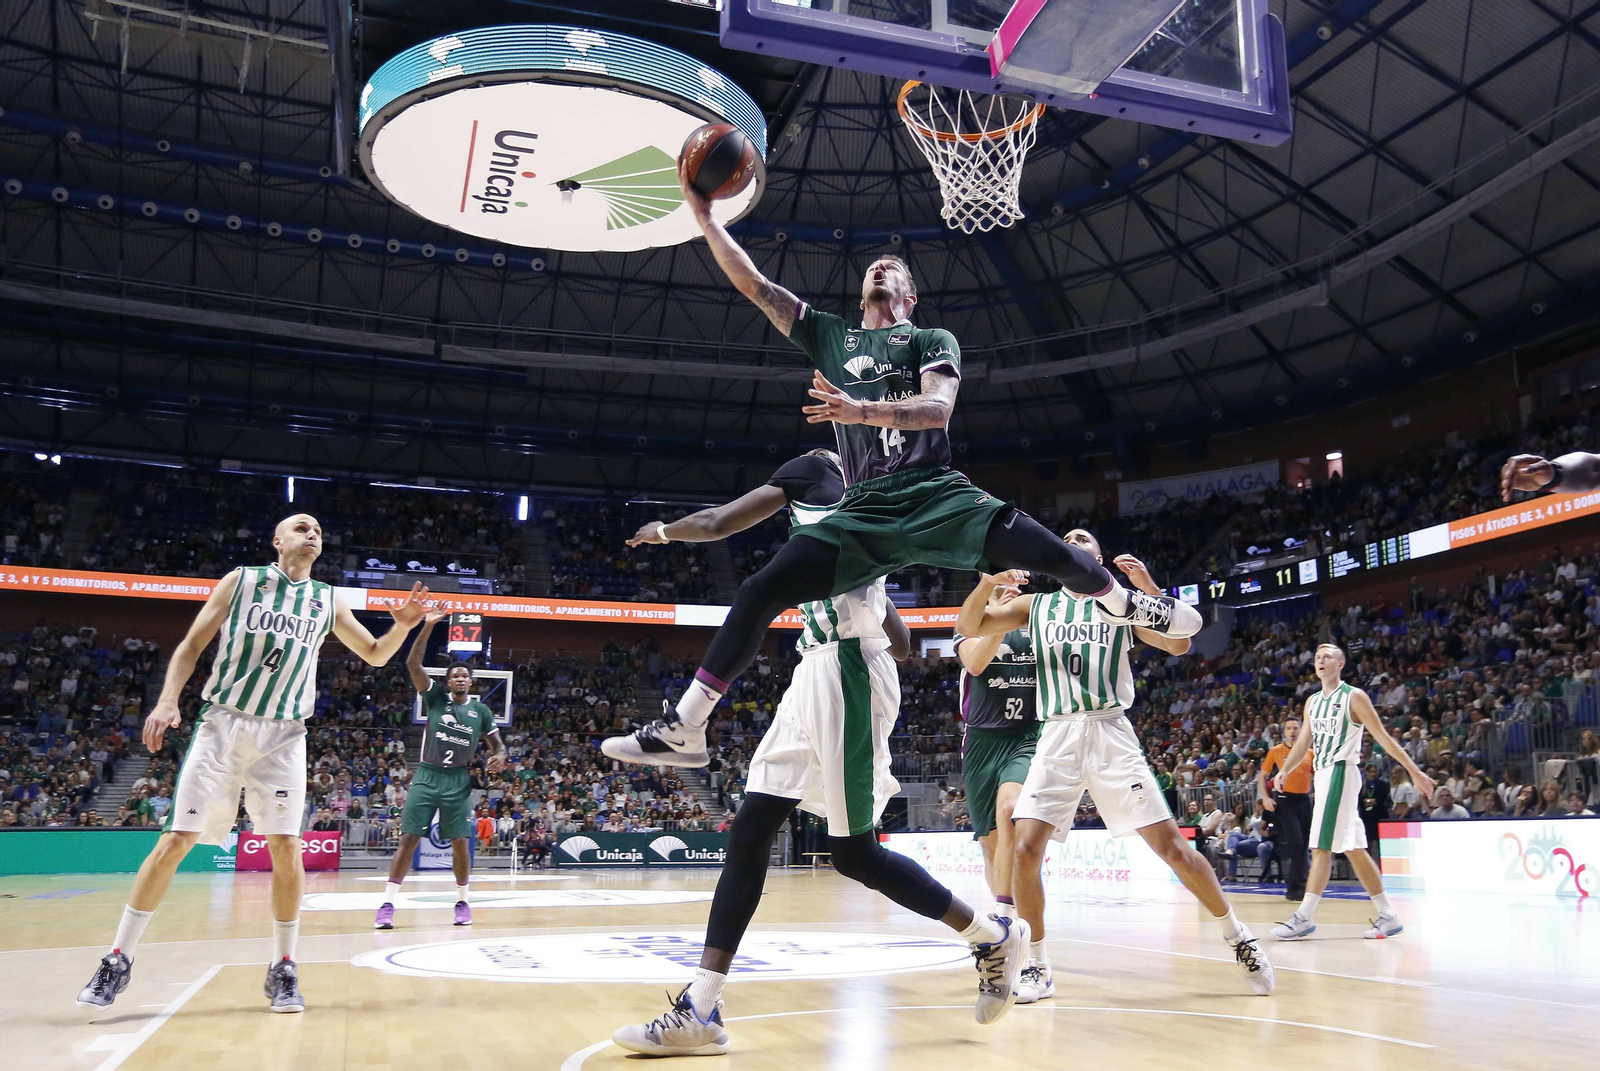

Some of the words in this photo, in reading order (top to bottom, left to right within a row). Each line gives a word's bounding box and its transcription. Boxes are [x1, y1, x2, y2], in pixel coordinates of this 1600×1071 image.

[471, 129, 538, 215] Unicaja
[874, 361, 913, 379] Uniaja
[880, 390, 921, 402] MÁLAG
[879, 427, 907, 456] 14
[1450, 526, 1476, 540] PISOS
[1477, 524, 1484, 534] Y
[1486, 514, 1519, 532] ÁTICOS
[1520, 510, 1533, 523] DE
[1535, 508, 1545, 520] 3,
[1547, 505, 1554, 516] 4
[1555, 502, 1562, 514] Y
[1565, 501, 1572, 511] 5
[8, 574, 19, 585] 3,
[21, 575, 29, 584] 4
[32, 575, 40, 584] Y
[42, 576, 50, 585] 5
[52, 577, 129, 591] DORMITORIOS,
[131, 582, 211, 595] APARCAMIENTO
[1276, 568, 1292, 586] 11
[1208, 582, 1226, 599] 17
[455, 601, 465, 610] 3,
[466, 602, 473, 610] 4
[475, 602, 481, 610] Y
[482, 603, 489, 611] 5
[490, 603, 553, 615] DORMITORIOS,
[555, 606, 622, 617] APARCAMIENTO
[624, 610, 630, 618] Y
[631, 610, 675, 620] TRASTERO
[246, 604, 317, 646] COOSUR
[451, 625, 482, 642] 3.7
[1045, 622, 1110, 645] COOSUR
[263, 647, 284, 673] 4
[1069, 653, 1083, 676] 0
[1009, 676, 1036, 684] MÁLAG
[1004, 697, 1024, 720] 52
[443, 749, 454, 765] 2
[596, 848, 644, 862] Unicaja
